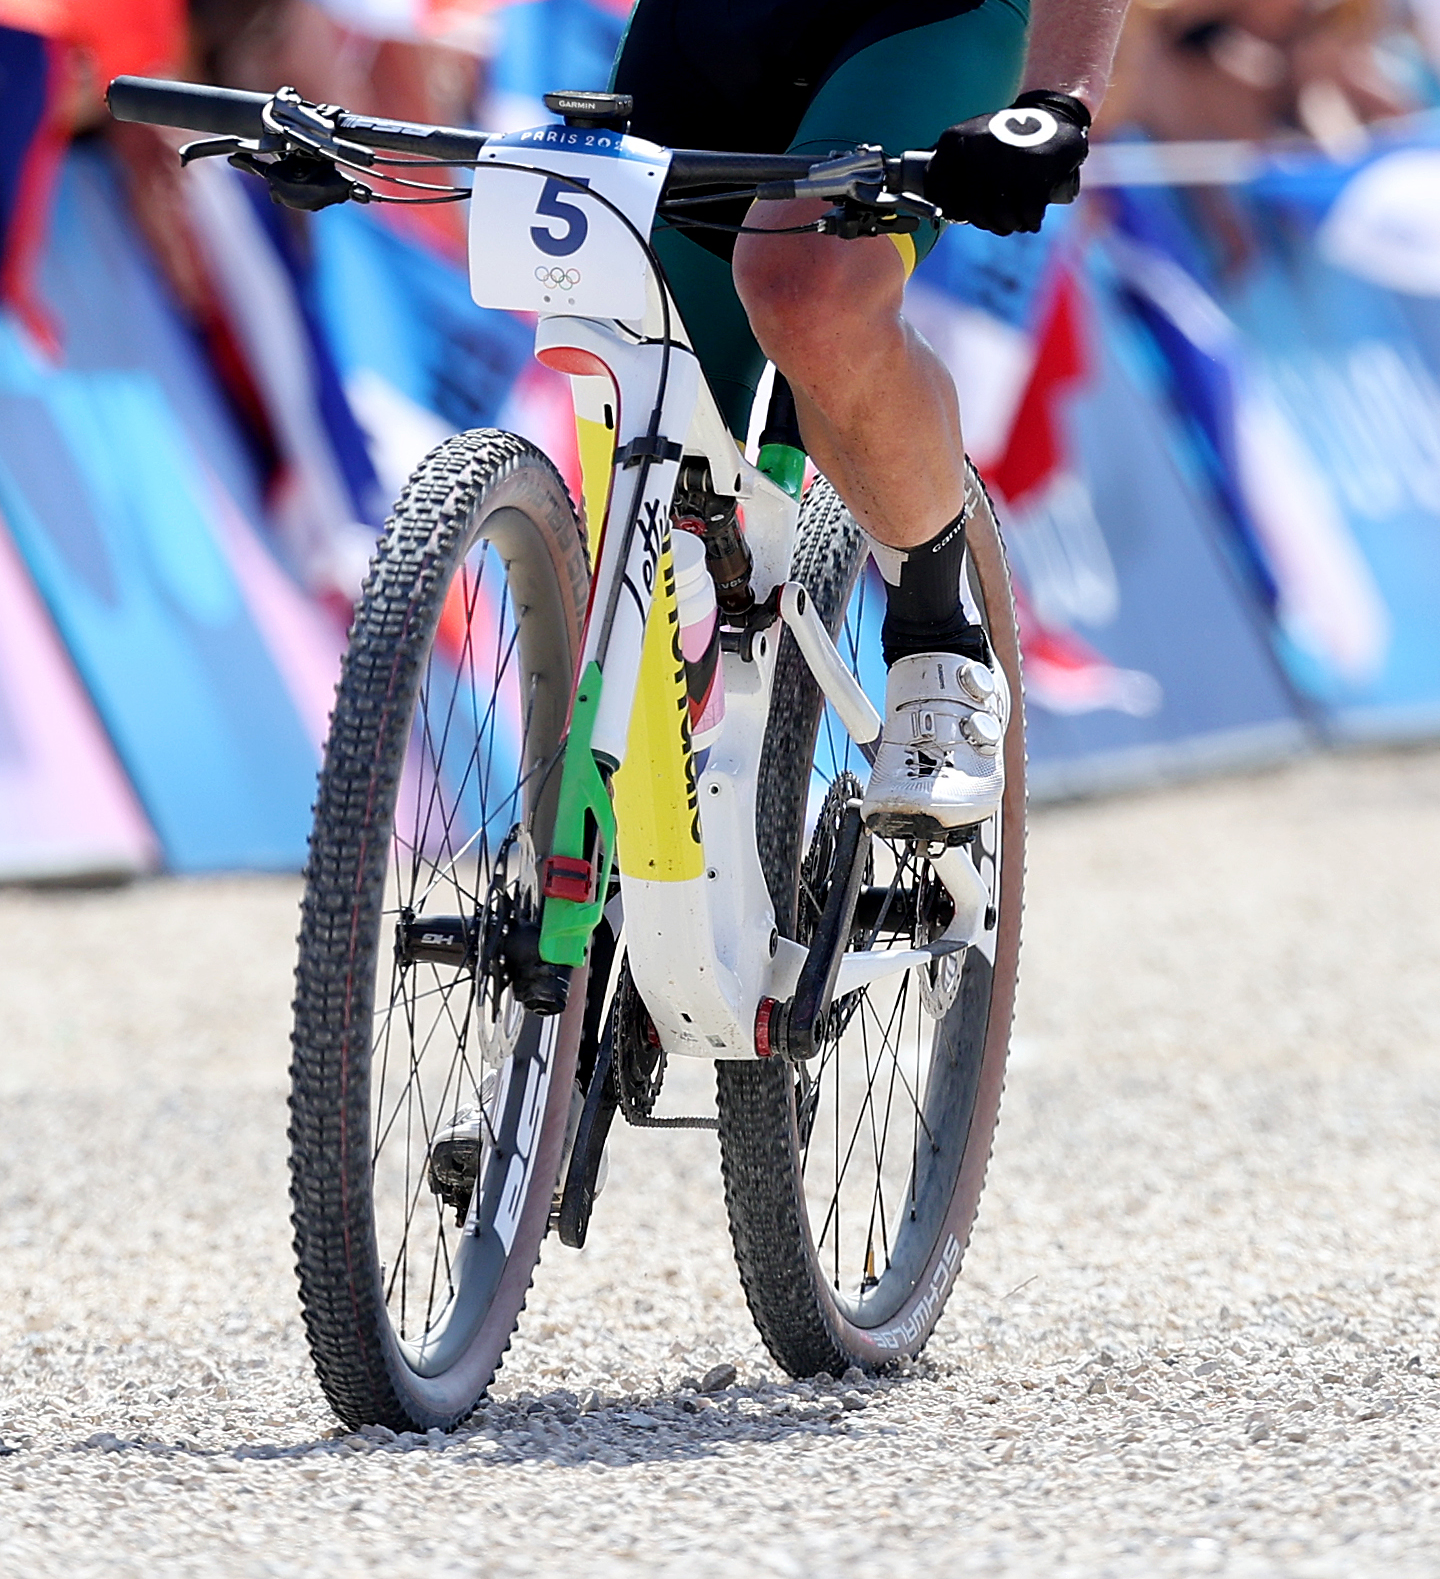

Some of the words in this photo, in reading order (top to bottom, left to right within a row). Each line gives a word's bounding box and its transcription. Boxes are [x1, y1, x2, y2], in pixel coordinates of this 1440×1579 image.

[558, 100, 596, 110] GARMIN
[521, 130, 577, 144] PARIS
[530, 175, 590, 258] 5
[868, 1232, 960, 1350] SCHWALBE
